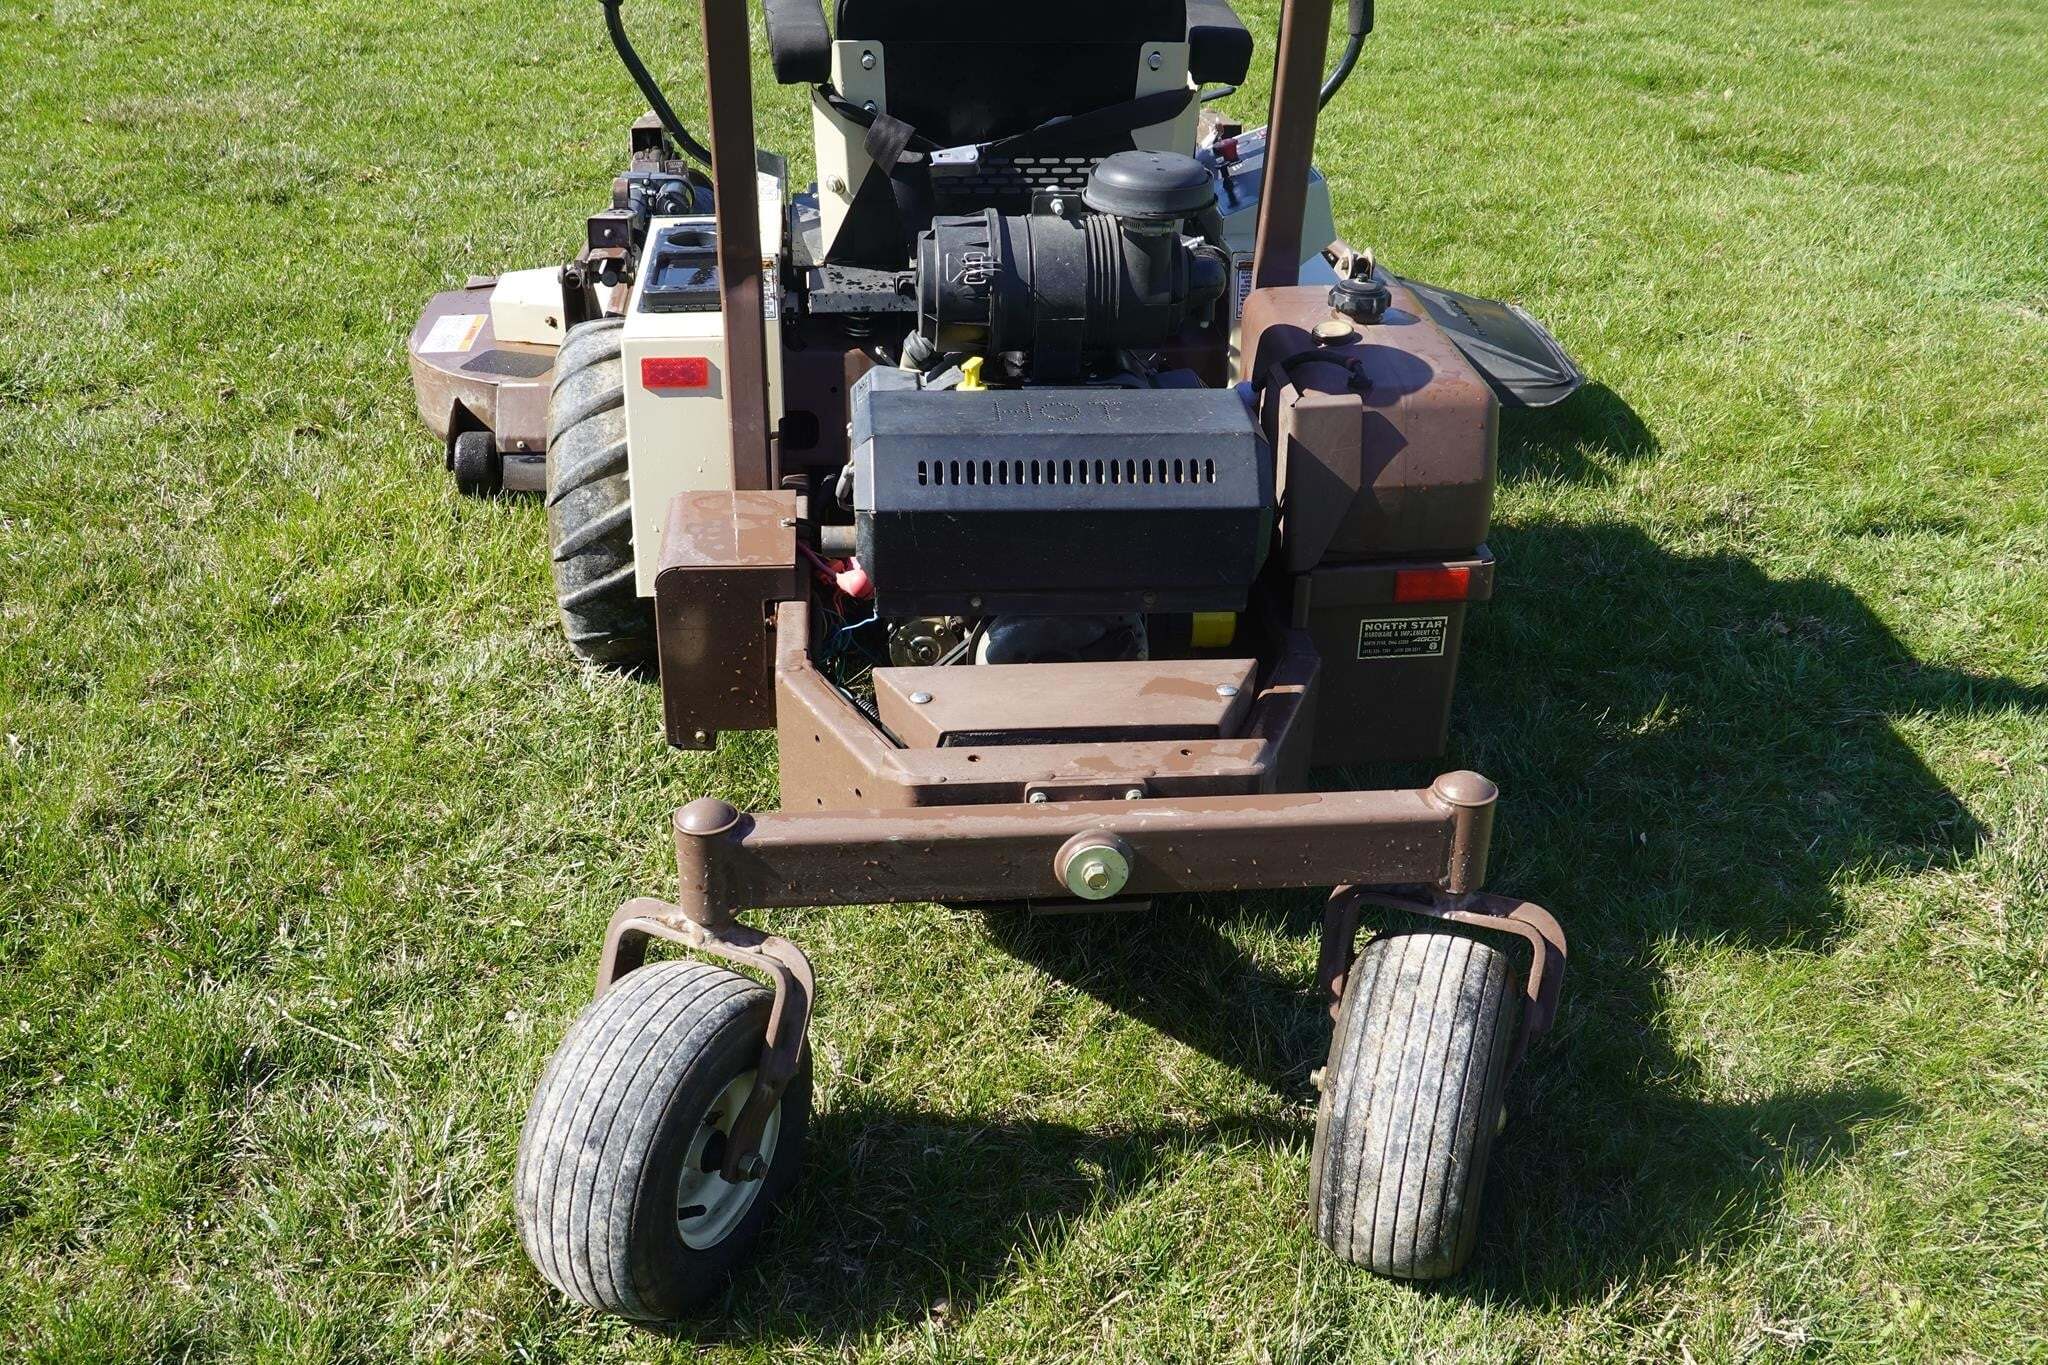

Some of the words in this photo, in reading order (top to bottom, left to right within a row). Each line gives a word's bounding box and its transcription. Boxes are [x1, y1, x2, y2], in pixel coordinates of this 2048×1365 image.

[992, 398, 1123, 422] HOT
[1364, 622, 1407, 631] NORTH
[1411, 620, 1442, 629] STAR
